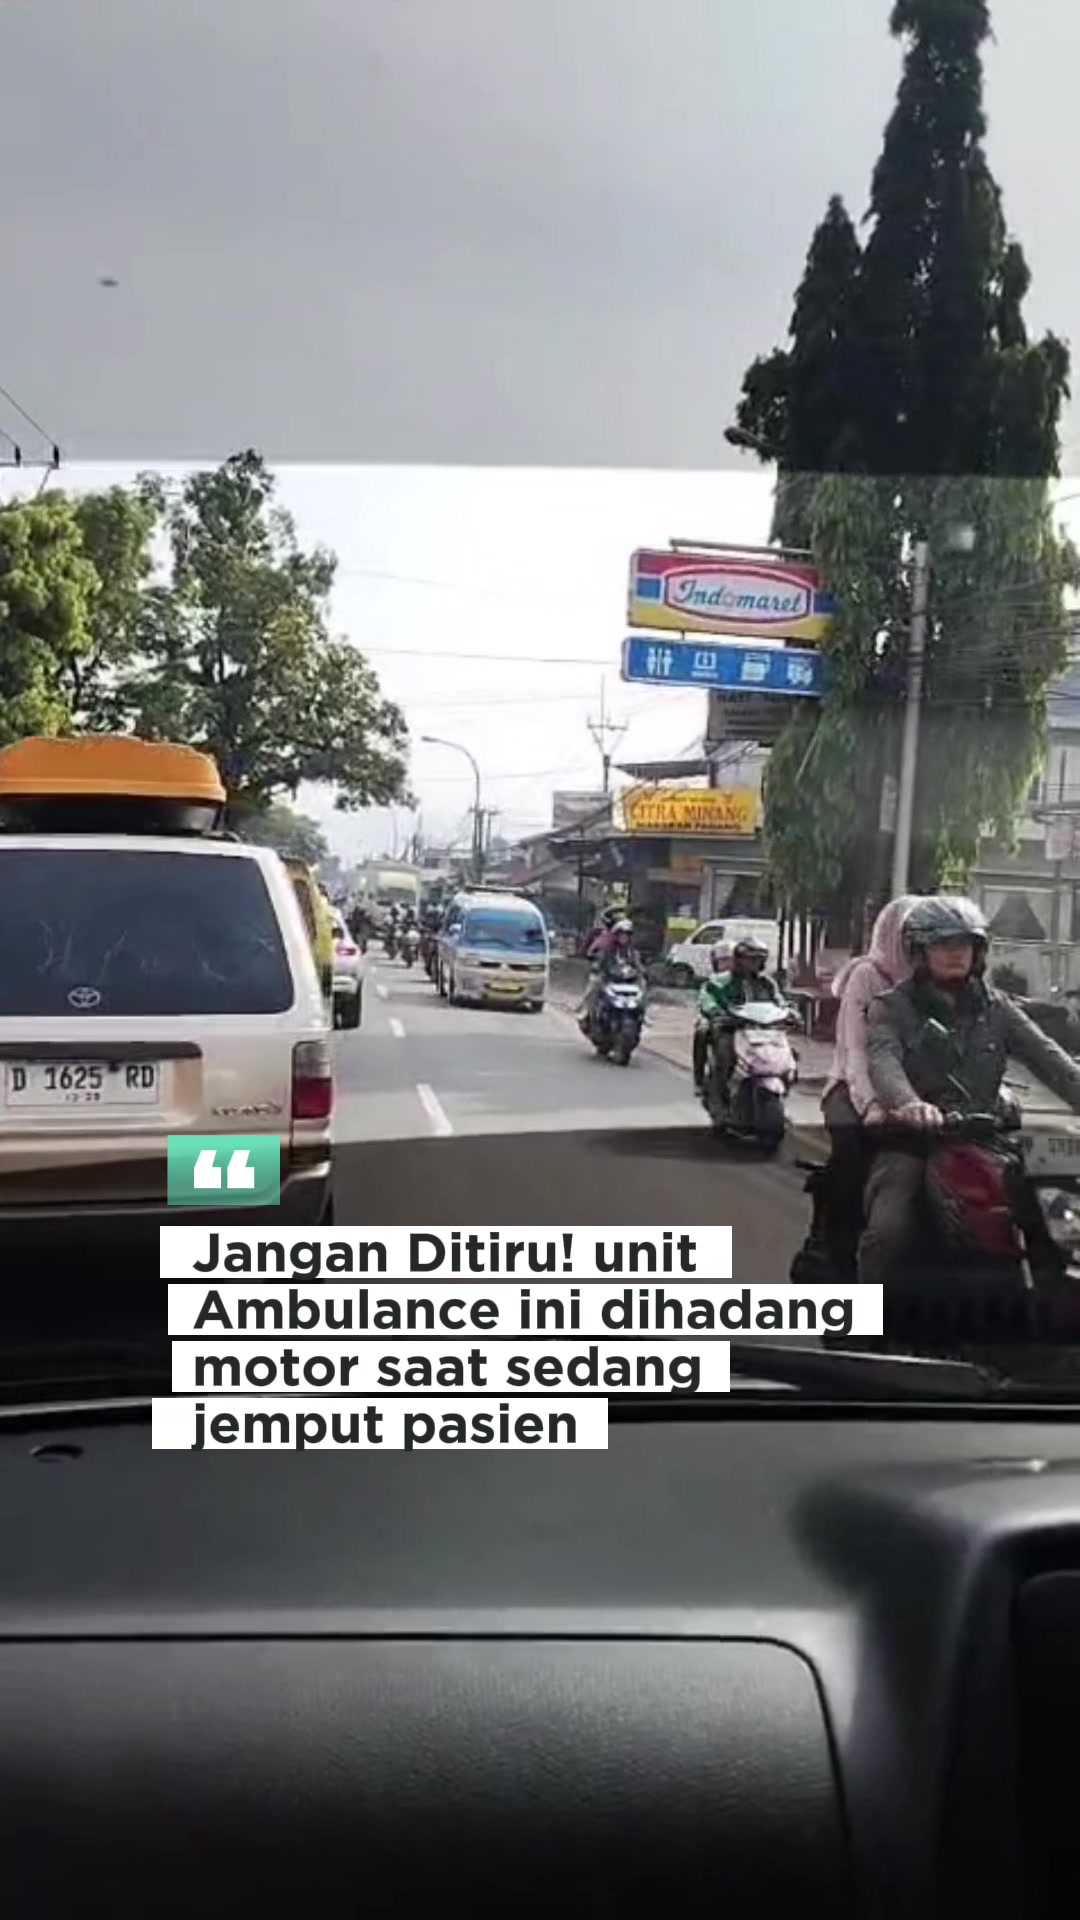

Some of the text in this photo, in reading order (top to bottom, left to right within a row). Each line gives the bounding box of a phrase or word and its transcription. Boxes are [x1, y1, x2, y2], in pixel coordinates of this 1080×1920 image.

[674, 578, 803, 613] Indomaret
[683, 804, 747, 822] MINANG
[12, 1064, 155, 1091] D 1625 RD
